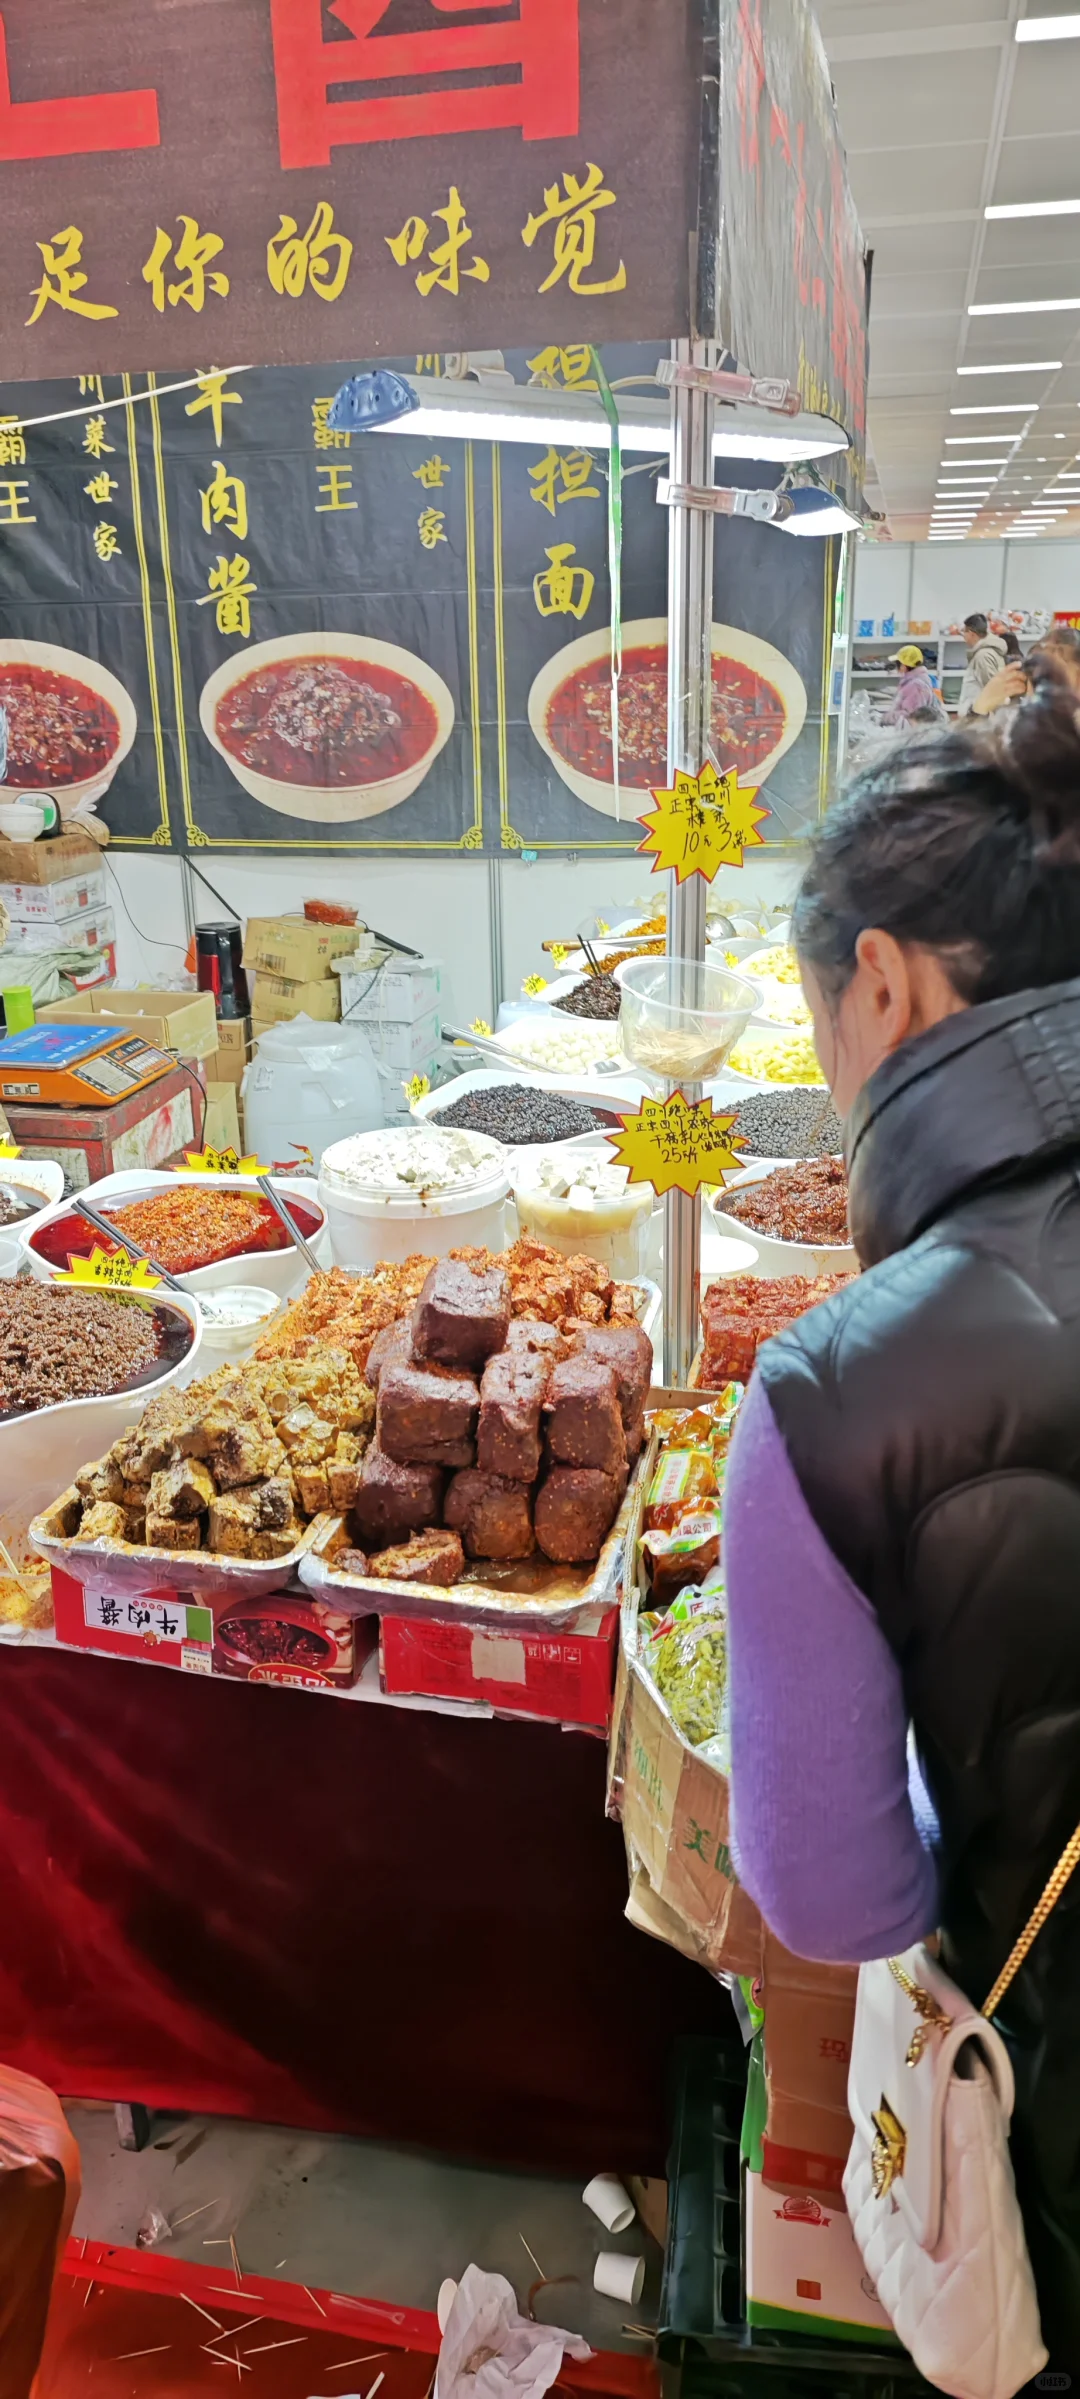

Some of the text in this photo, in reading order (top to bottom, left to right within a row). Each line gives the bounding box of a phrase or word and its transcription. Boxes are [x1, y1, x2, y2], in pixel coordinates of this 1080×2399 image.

[25, 162, 627, 327] 足你的味觉
[525, 344, 602, 620] 担担面
